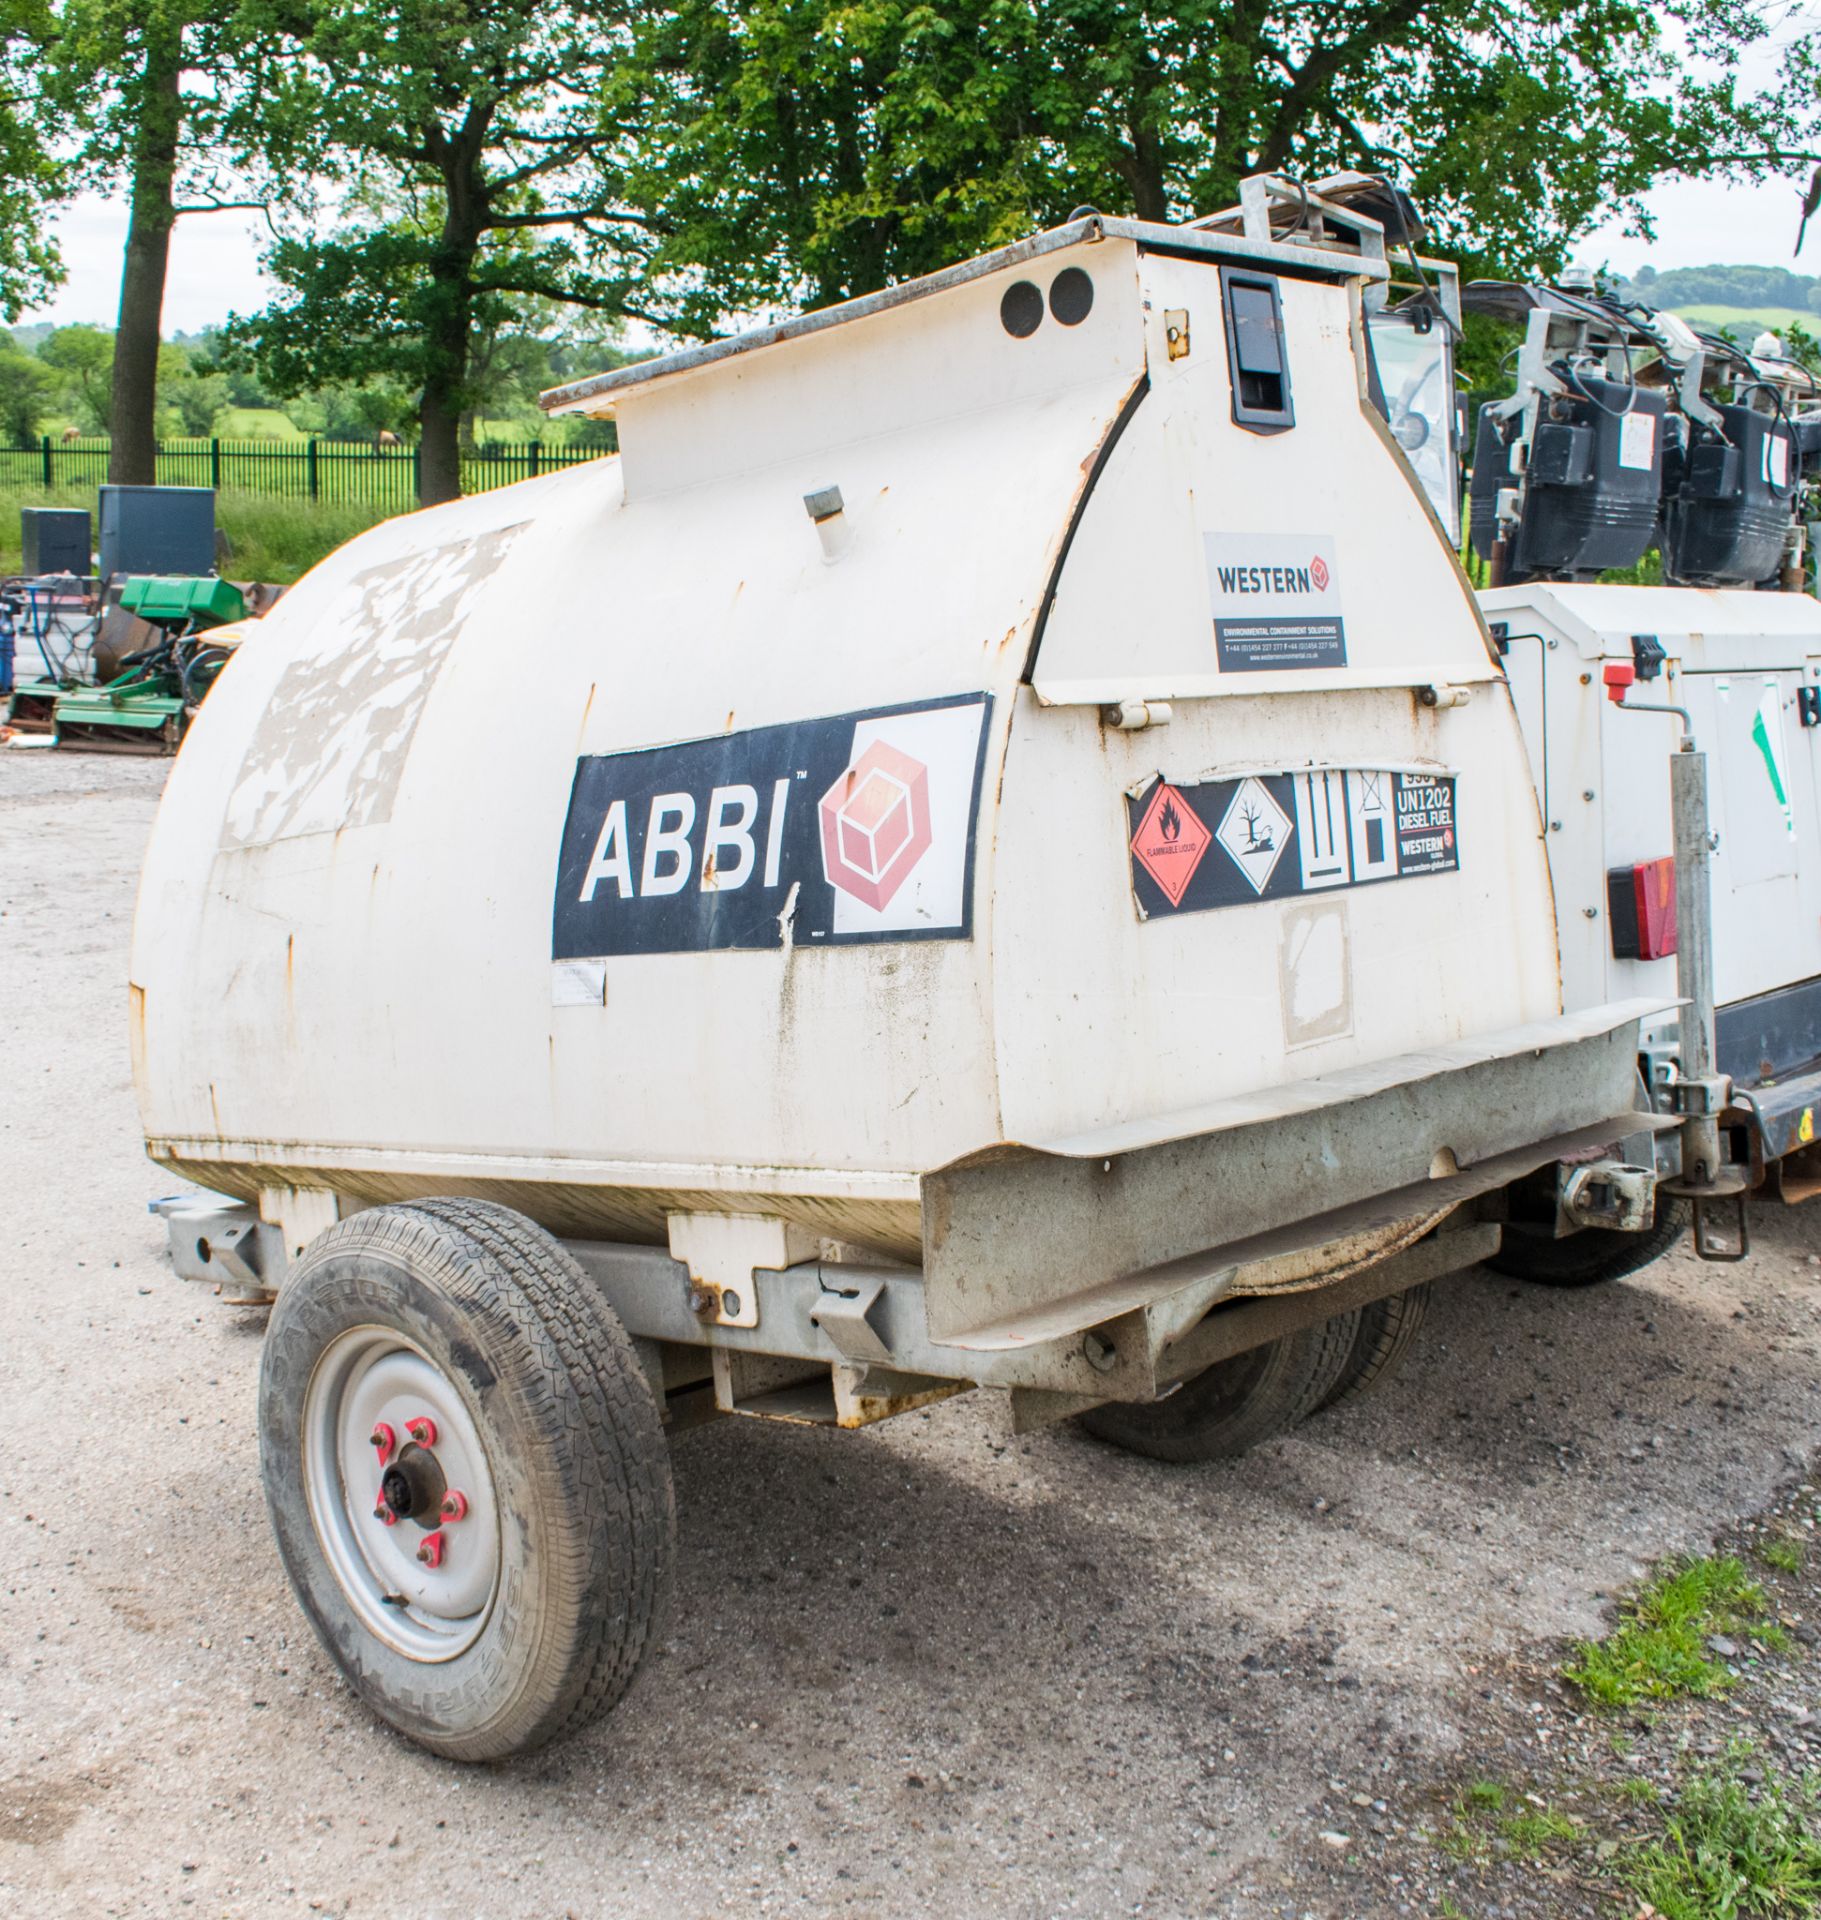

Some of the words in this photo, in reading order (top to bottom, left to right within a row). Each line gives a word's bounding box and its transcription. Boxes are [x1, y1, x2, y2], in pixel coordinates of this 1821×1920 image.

[1217, 567, 1310, 593] WESTERN
[1223, 627, 1269, 637] ENVIRONMENTAL
[1308, 626, 1337, 634] SOLUTIONS
[1397, 787, 1451, 812] UN1202
[1399, 812, 1430, 830] DIESEL
[1430, 809, 1453, 826] FUEL
[579, 779, 790, 902] ABBI
[1147, 846, 1178, 857] FLAMMABLE
[1179, 843, 1196, 853] LIQUID
[1401, 836, 1445, 856] WESTERN
[1172, 881, 1177, 891] 3
